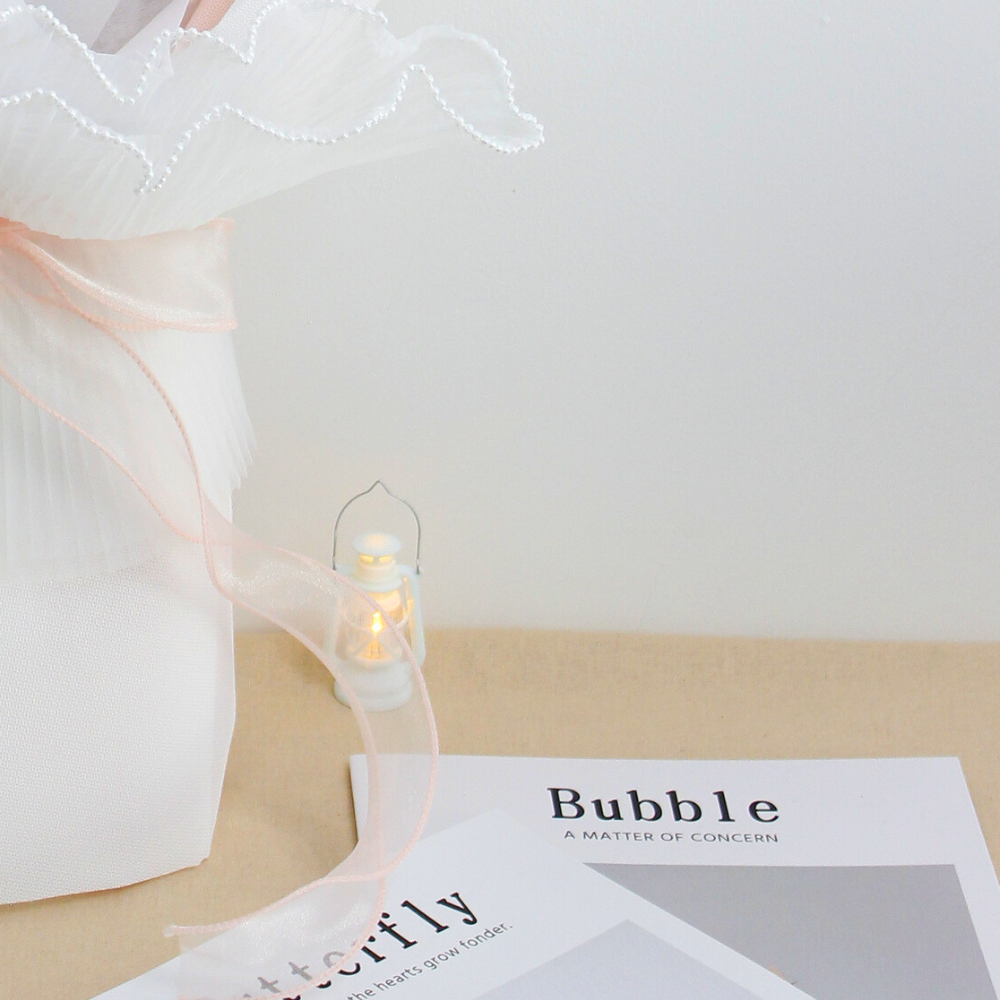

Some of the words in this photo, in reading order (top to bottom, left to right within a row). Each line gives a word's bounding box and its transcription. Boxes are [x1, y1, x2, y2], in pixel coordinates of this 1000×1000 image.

[547, 788, 779, 823] Bubble
[563, 831, 575, 840] A
[582, 831, 653, 842] MATTER
[660, 833, 683, 842] OF
[691, 833, 779, 843] CONCERN
[243, 892, 478, 1000] tterfly
[373, 965, 422, 991] hearts
[423, 947, 460, 970] grow
[459, 922, 513, 949] fonder.
